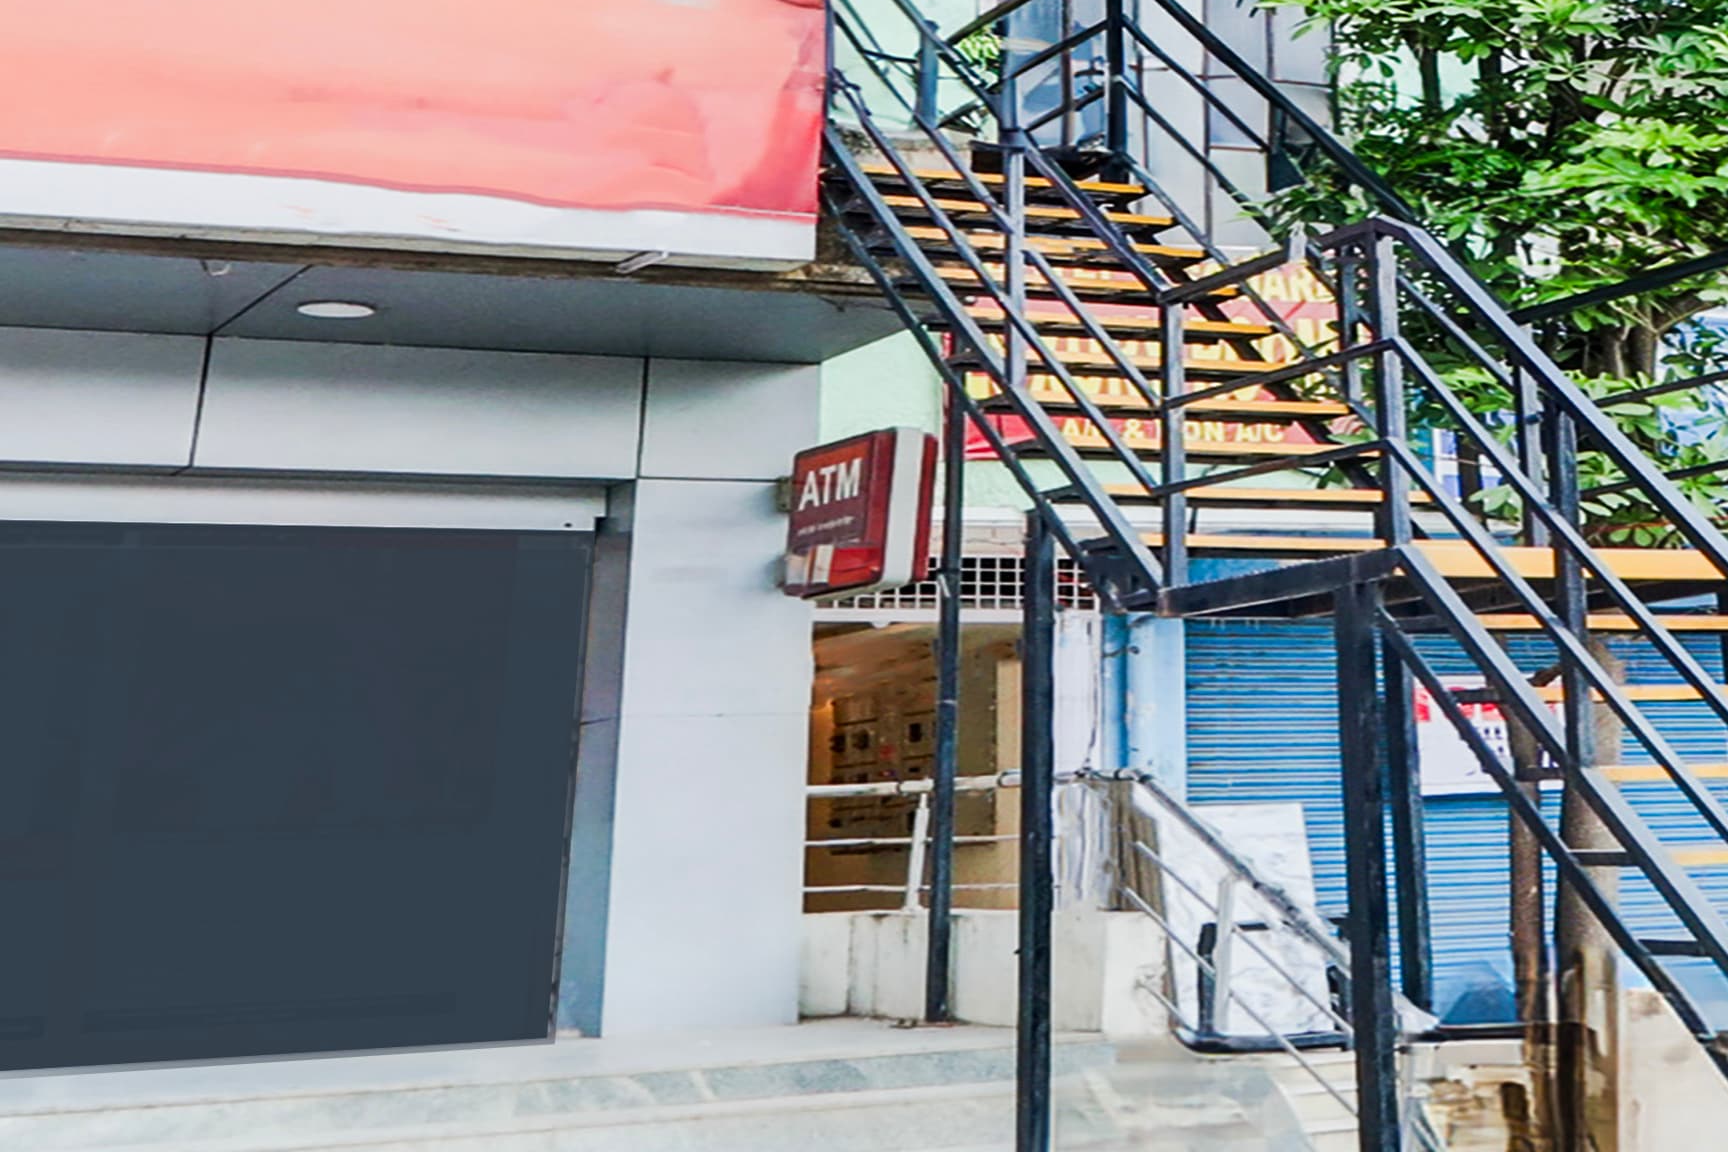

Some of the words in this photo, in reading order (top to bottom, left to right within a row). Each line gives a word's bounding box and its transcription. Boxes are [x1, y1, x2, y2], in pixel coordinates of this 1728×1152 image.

[1122, 418, 1144, 441] &
[1155, 419, 1226, 442] ON
[798, 457, 862, 511] ATM
